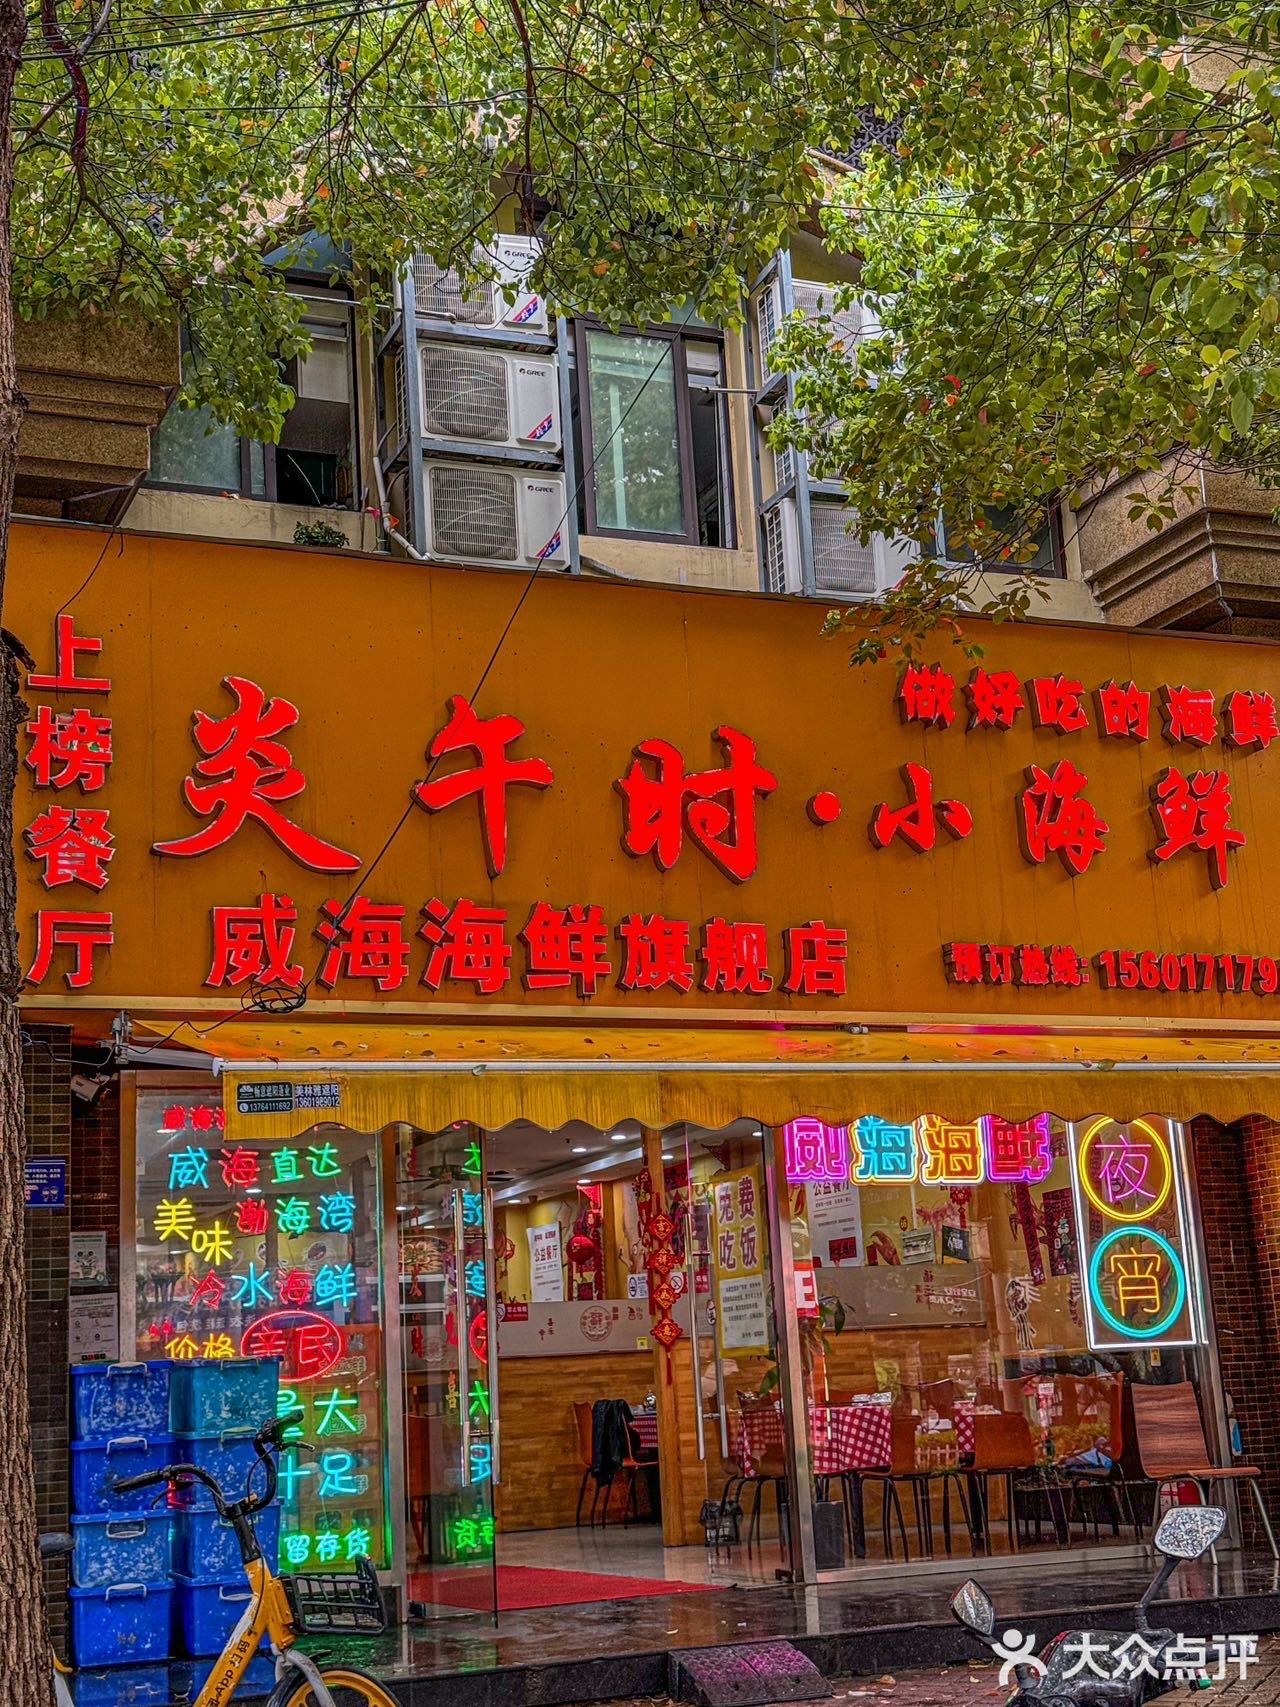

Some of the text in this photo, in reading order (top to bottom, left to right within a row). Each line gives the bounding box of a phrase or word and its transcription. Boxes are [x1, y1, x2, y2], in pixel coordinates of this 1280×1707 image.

[526, 369, 546, 377] GREE
[535, 484, 555, 493] GREE
[902, 664, 1279, 750] 做好吃的海鲜
[26, 614, 115, 988] 上榜餐厅
[206, 893, 848, 996] 威海海鲜旗舰店
[249, 1101, 291, 1112] 13764111692
[168, 1142, 344, 1190] 威海直达
[784, 1113, 1053, 1186] 威海海鲜
[718, 1175, 756, 1226] 免费
[718, 1225, 759, 1271] 吃饭
[188, 1262, 358, 1309] 冷水海鲜
